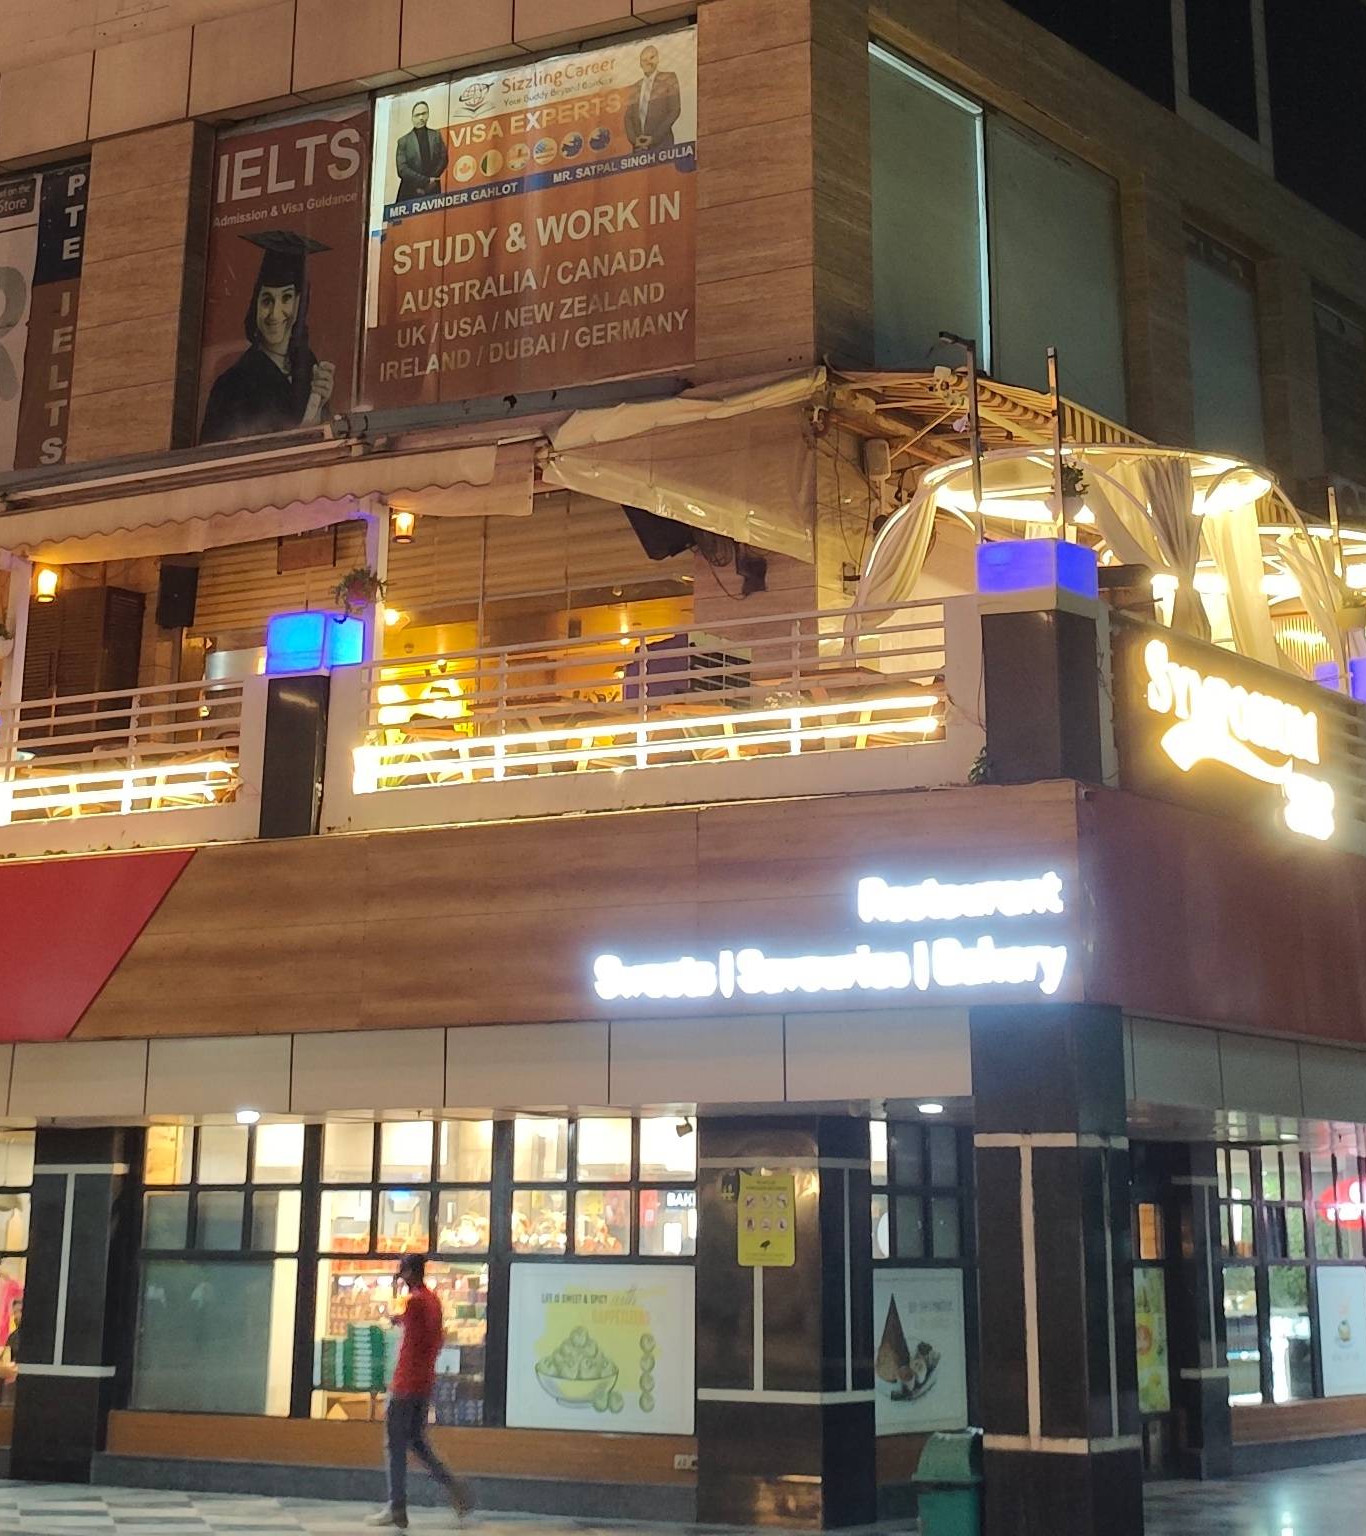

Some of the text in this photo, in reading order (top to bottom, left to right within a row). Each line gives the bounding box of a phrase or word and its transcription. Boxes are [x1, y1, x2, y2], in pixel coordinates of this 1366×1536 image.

[501, 66, 562, 94] Sizzling
[566, 57, 616, 79] Career
[449, 93, 622, 148] VISA EXPERTS
[217, 128, 361, 204] IELTS
[553, 144, 694, 183] MR. SATPAL SINGH GULIA
[62, 173, 86, 261] PTE
[213, 191, 358, 228] Admission & Visa Guidance
[389, 181, 519, 219] MR. RAVINDER GAHLOT
[393, 190, 681, 275] STUDY & WORK IN
[399, 267, 538, 315] AUSTRALIA
[556, 243, 665, 285] CANADA
[379, 347, 472, 383] IRELAND
[489, 331, 557, 363] DUBAI
[574, 308, 689, 348] GERMANY
[396, 324, 427, 349] UK
[443, 314, 487, 341] USA
[504, 301, 555, 330] NEW
[559, 281, 665, 320] ZEALAND
[38, 291, 73, 465] IELTS
